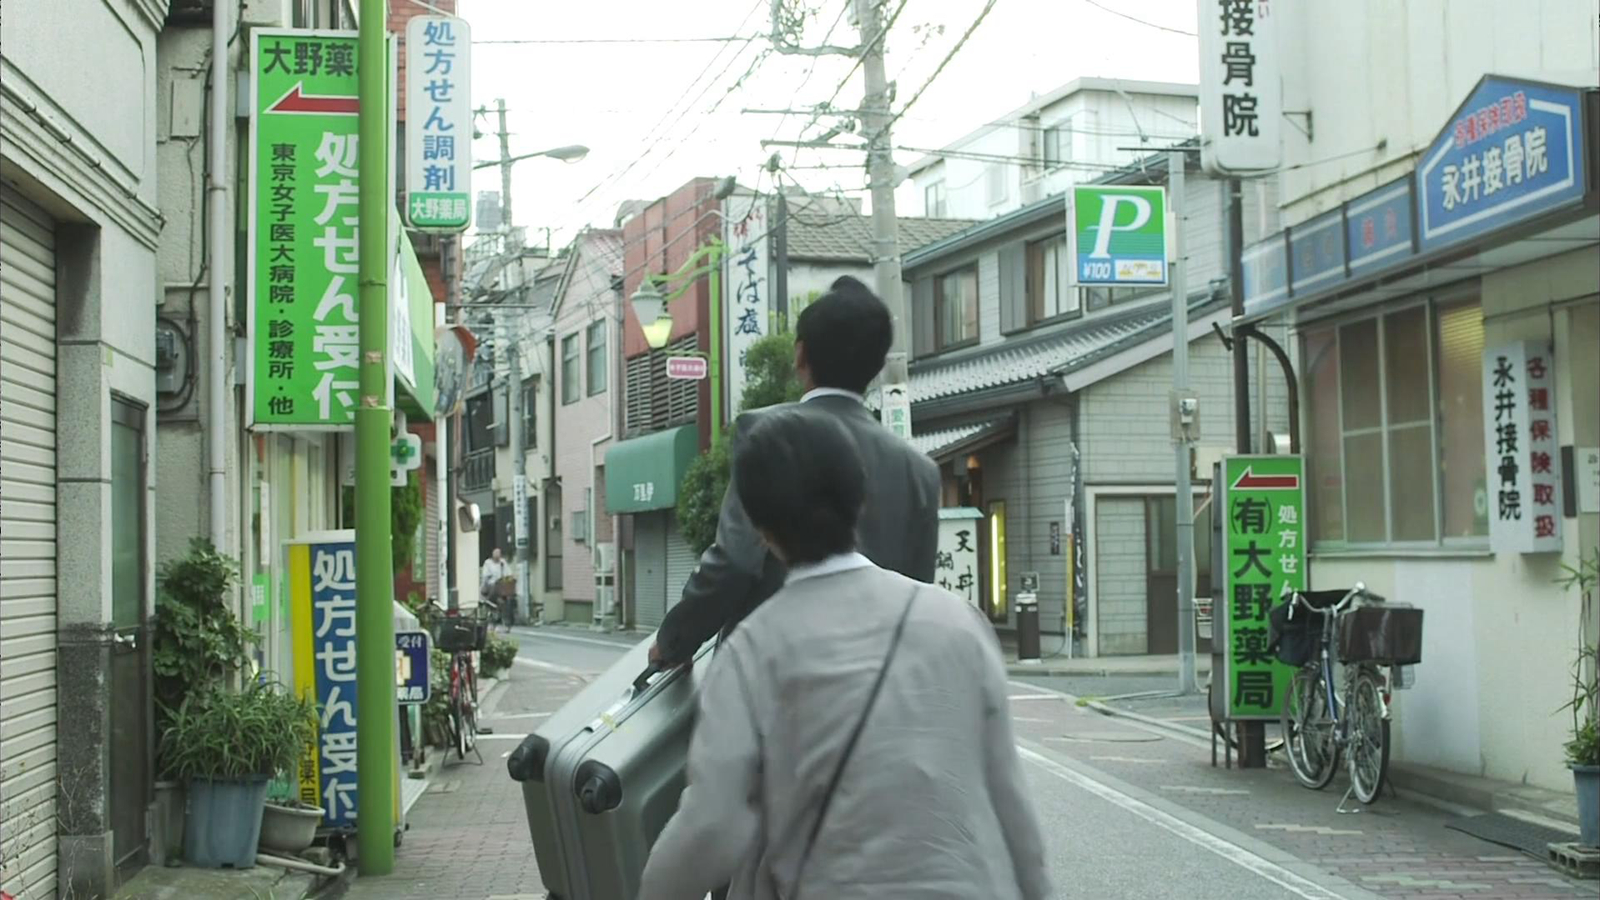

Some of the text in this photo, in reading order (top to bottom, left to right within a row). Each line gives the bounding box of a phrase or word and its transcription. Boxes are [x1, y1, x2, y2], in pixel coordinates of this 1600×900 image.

[263, 41, 359, 77] 大野薬
[423, 21, 455, 191] 処方せん調剤
[1219, 0, 1260, 138] 接骨院
[412, 198, 467, 220] 大野薬局
[1442, 126, 1548, 210] 永井接骨院
[312, 131, 359, 420] 処方せん受付
[1083, 262, 1111, 279] ¥100
[1085, 194, 1152, 259] P
[1493, 356, 1522, 521] 永井接骨院
[1527, 356, 1555, 539] 各種保険取扱
[955, 529, 974, 601] 天丼
[313, 550, 357, 821] 処方せん受付
